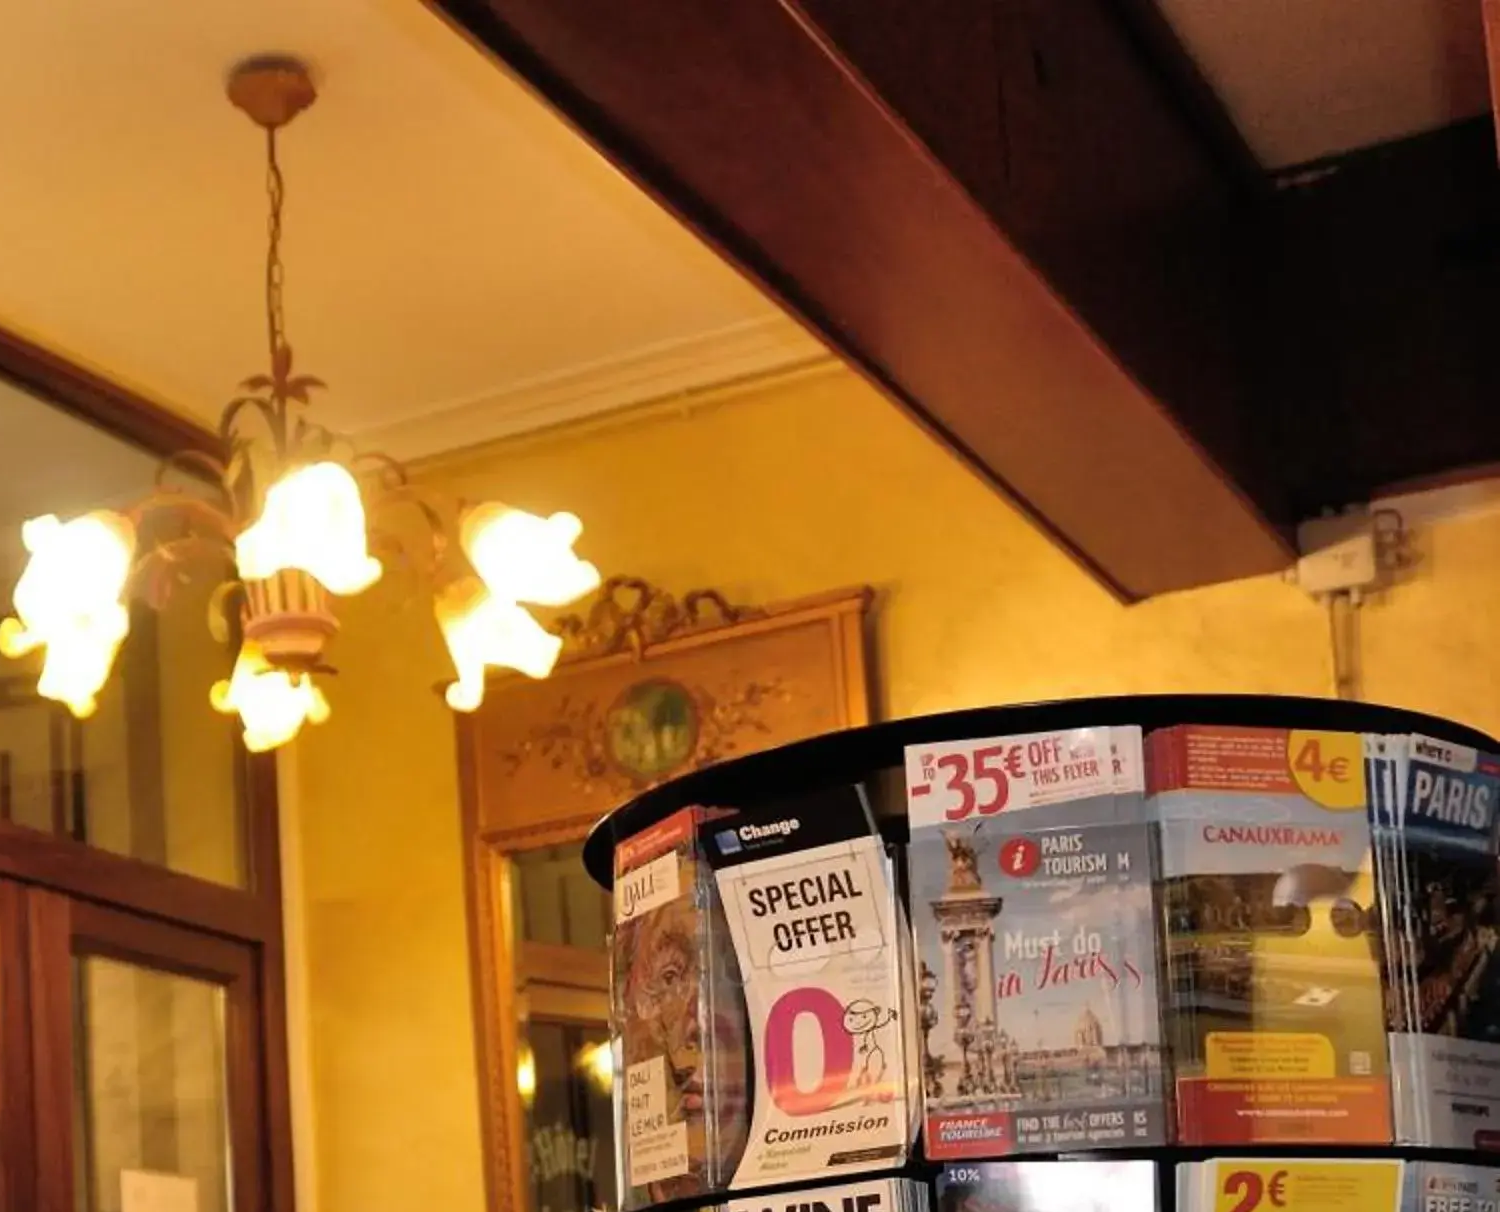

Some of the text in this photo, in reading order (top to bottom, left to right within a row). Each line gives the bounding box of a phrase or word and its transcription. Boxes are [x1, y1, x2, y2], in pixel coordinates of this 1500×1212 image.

[1027, 736, 1062, 767] OFF
[1294, 738, 1349, 783] 4€
[1032, 768, 1060, 785] THIS
[1412, 769, 1490, 830] PARIS
[739, 817, 801, 841] Change
[1040, 833, 1083, 855] PARIS
[1203, 824, 1341, 846] CANAUXRAMA
[1043, 852, 1108, 876] TOURISM
[748, 868, 863, 918] SPECIAL
[773, 910, 857, 953] OFFER
[1004, 925, 1102, 960] Must do
[764, 987, 855, 1117] 0
[764, 1115, 890, 1145] Commission
[949, 1168, 981, 1182] 10%
